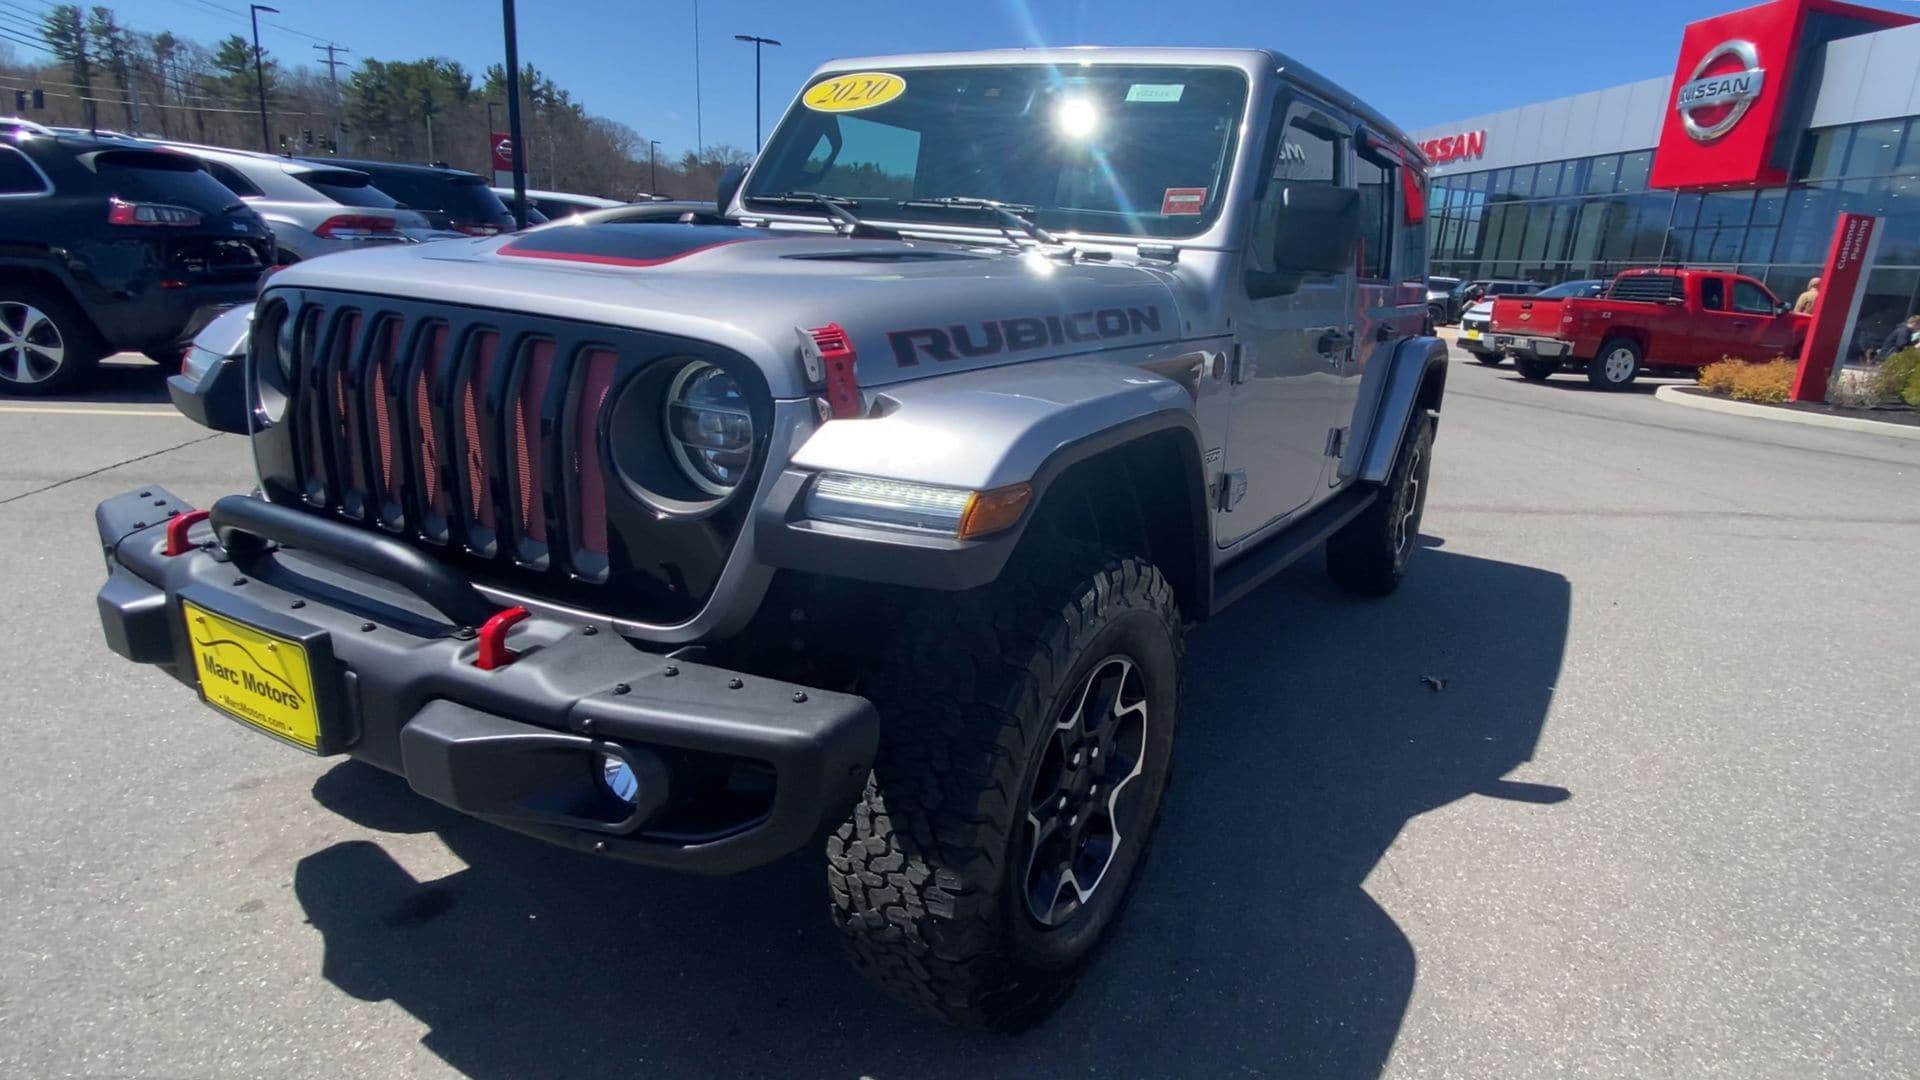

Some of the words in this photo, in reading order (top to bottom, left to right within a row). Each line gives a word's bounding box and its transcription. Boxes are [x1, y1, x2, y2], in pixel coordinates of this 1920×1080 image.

[815, 80, 892, 104] 2020
[1681, 76, 1751, 102] NISSAN
[1838, 218, 1857, 270] Customer
[1850, 220, 1869, 260] Parking
[885, 306, 1162, 368] RUBICON
[202, 652, 239, 685] Marc
[242, 670, 300, 710] Motors
